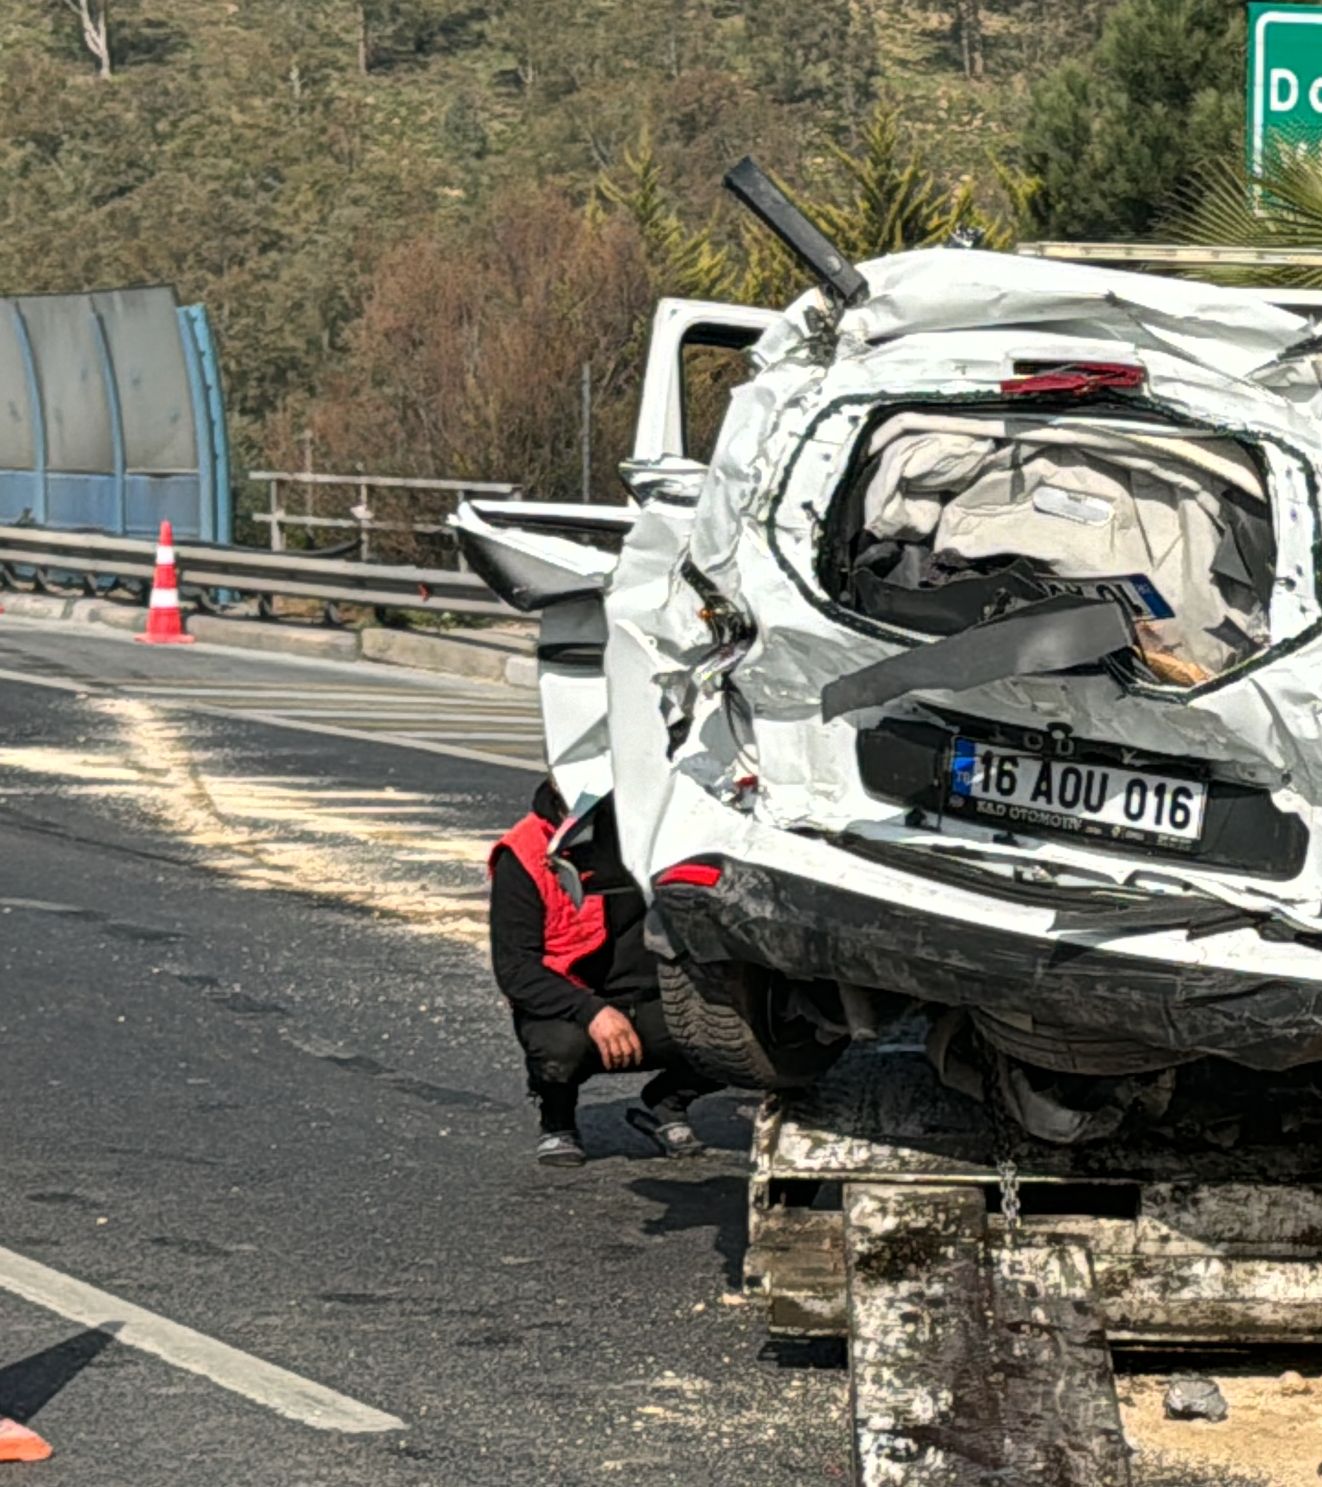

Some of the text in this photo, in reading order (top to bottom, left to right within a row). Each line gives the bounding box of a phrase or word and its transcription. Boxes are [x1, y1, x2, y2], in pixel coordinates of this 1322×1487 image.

[981, 750, 1194, 830] 16 AOU 016
